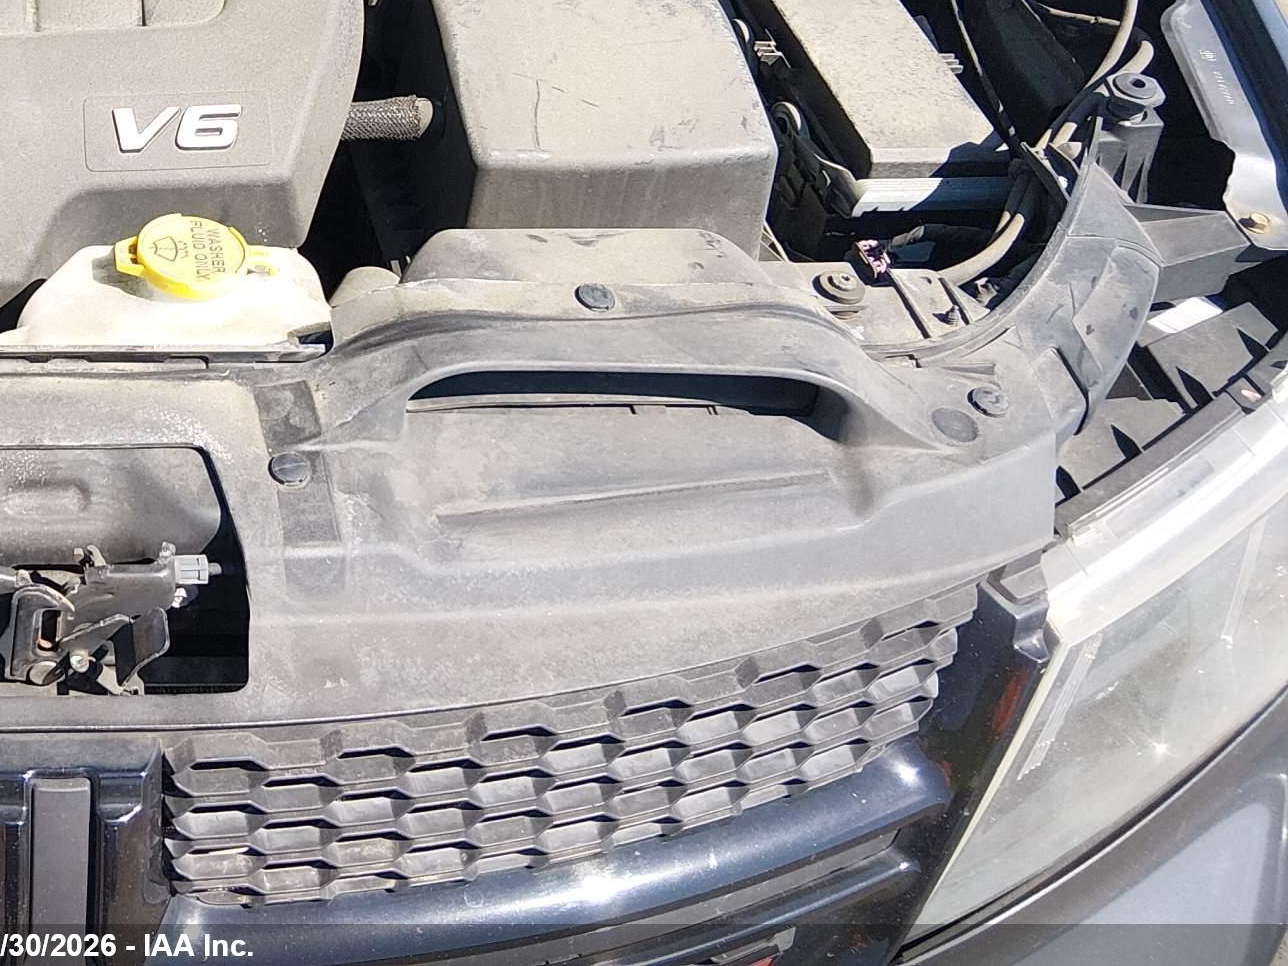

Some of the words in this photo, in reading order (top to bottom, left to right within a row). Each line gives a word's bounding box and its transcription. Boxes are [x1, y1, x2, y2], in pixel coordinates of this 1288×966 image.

[112, 104, 243, 153] V6
[190, 220, 206, 250] FLUID
[206, 228, 226, 273] WASHER
[194, 253, 210, 281] ONLY
